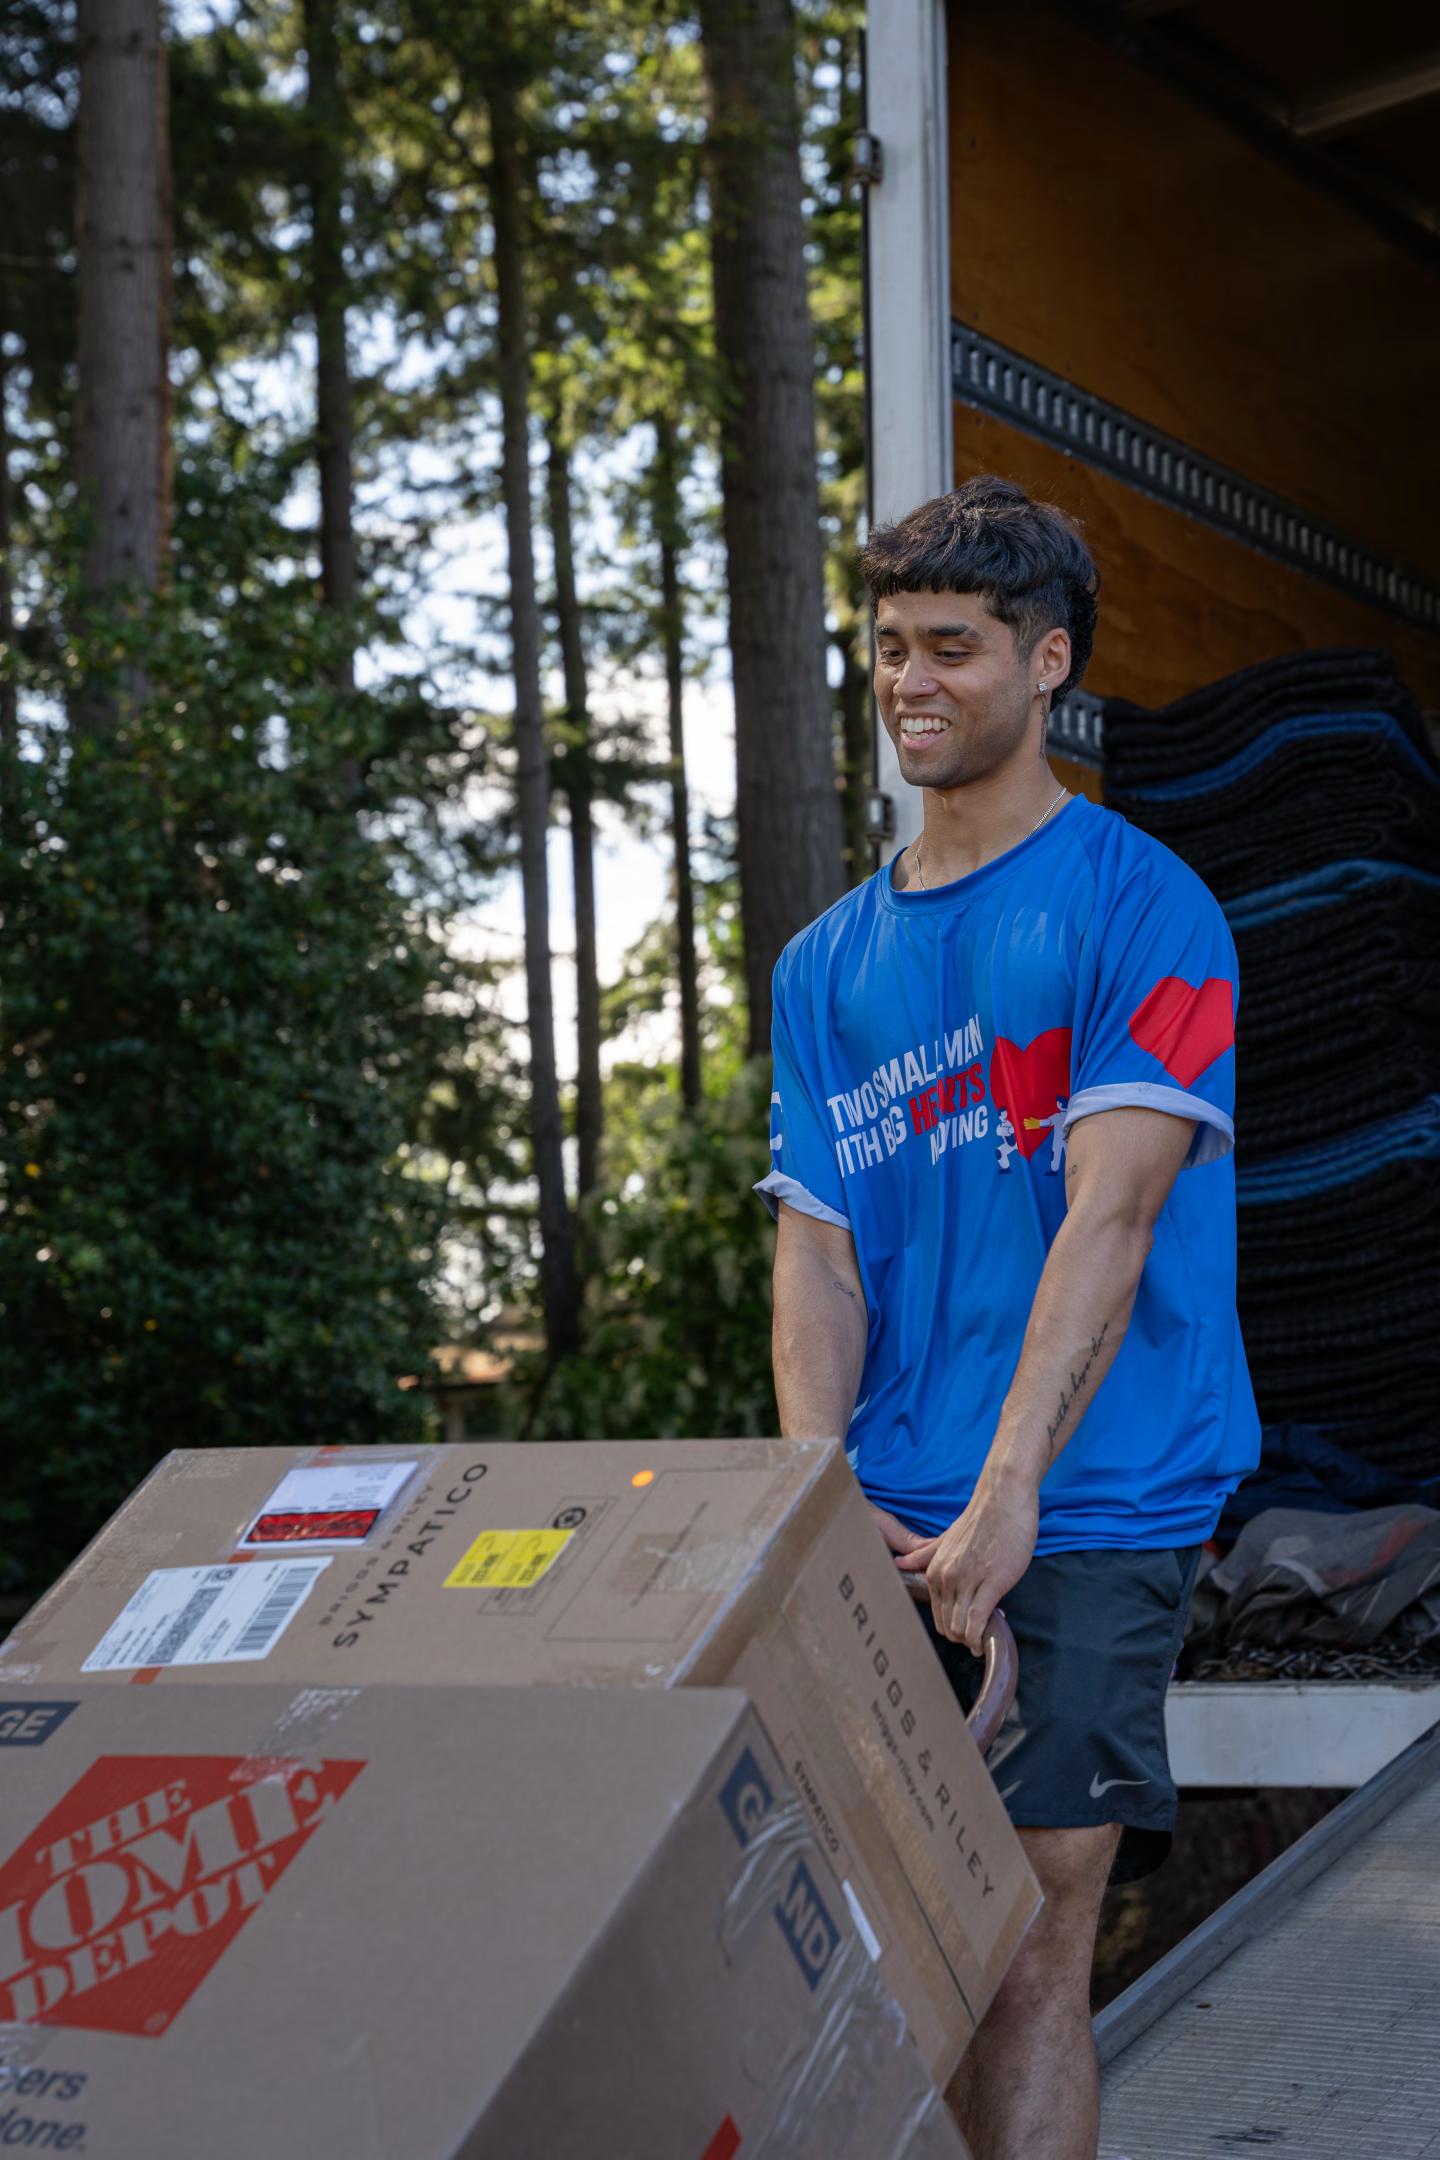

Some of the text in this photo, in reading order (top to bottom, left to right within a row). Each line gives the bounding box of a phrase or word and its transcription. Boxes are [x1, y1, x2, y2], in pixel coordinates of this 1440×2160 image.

[873, 1040, 944, 1109] SMALL
[880, 1106, 908, 1157] BG
[332, 1464, 488, 1648] SYMPATICO
[838, 1573, 995, 1897] BRIGGS & RILEY
[35, 1778, 192, 1878] THE
[6, 1853, 276, 2023] DEPOT
